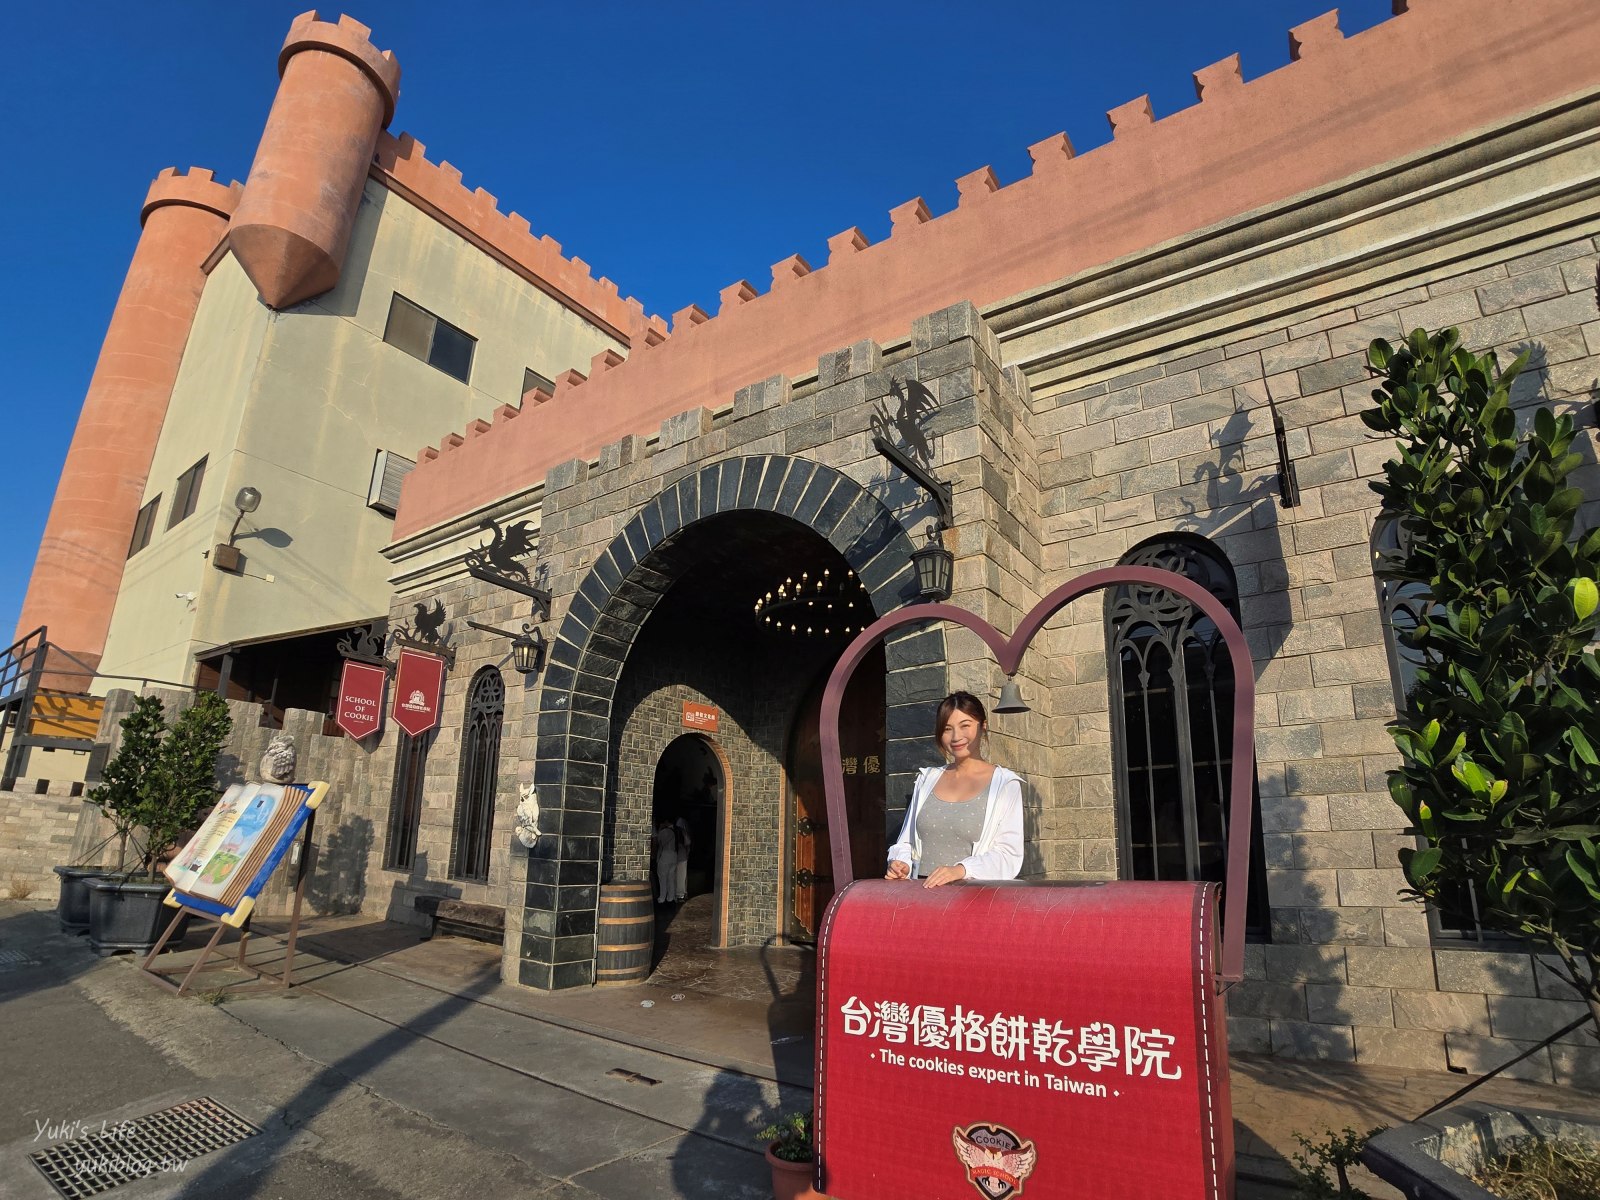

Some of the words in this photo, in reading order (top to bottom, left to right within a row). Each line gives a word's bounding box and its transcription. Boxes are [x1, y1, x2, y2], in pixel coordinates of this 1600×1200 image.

[345, 695, 376, 706] SCHOOL
[344, 711, 374, 721] COOKIE
[840, 995, 1182, 1080] 台灣優格餅乾學院
[879, 1048, 905, 1066] The
[908, 1056, 965, 1076] cookies
[968, 1065, 1021, 1084] expert
[1024, 1070, 1040, 1088] in
[1044, 1073, 1107, 1098] Taiwan
[975, 1135, 1011, 1149] COOKIE
[993, 1170, 1017, 1185] SCHOOL
